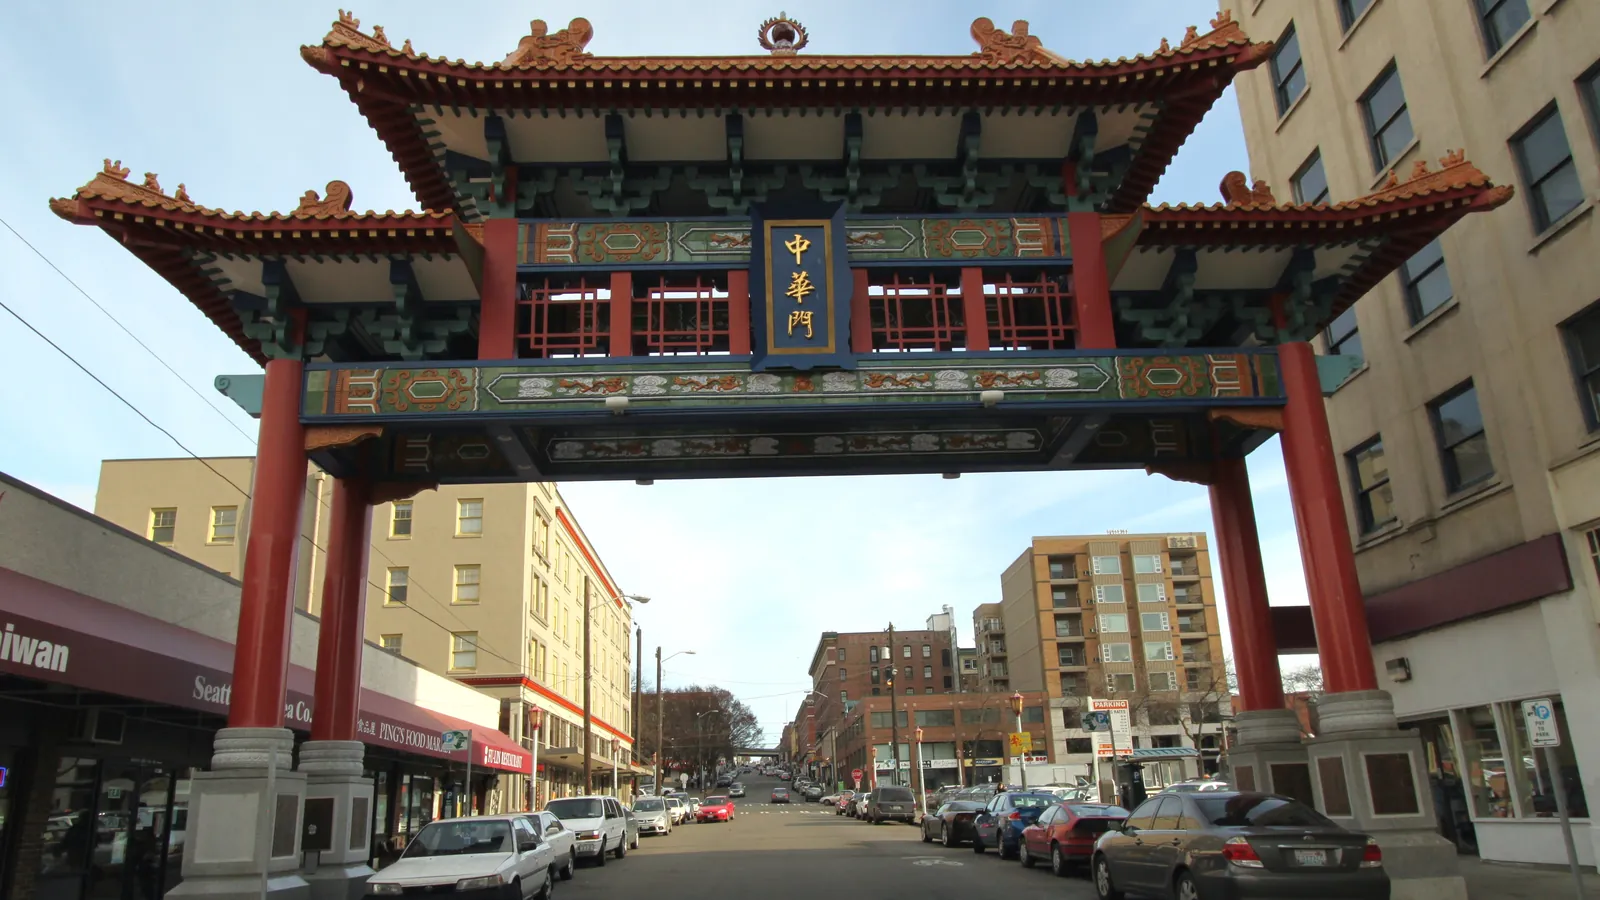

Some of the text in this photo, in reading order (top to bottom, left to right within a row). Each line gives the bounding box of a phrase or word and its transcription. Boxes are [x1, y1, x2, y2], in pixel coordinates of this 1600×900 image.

[784, 234, 815, 338] 中華門
[0, 622, 69, 672] iwan
[192, 675, 231, 706] Seatt
[296, 701, 312, 723] Co.
[379, 722, 451, 754] PING'S FOOD MAR
